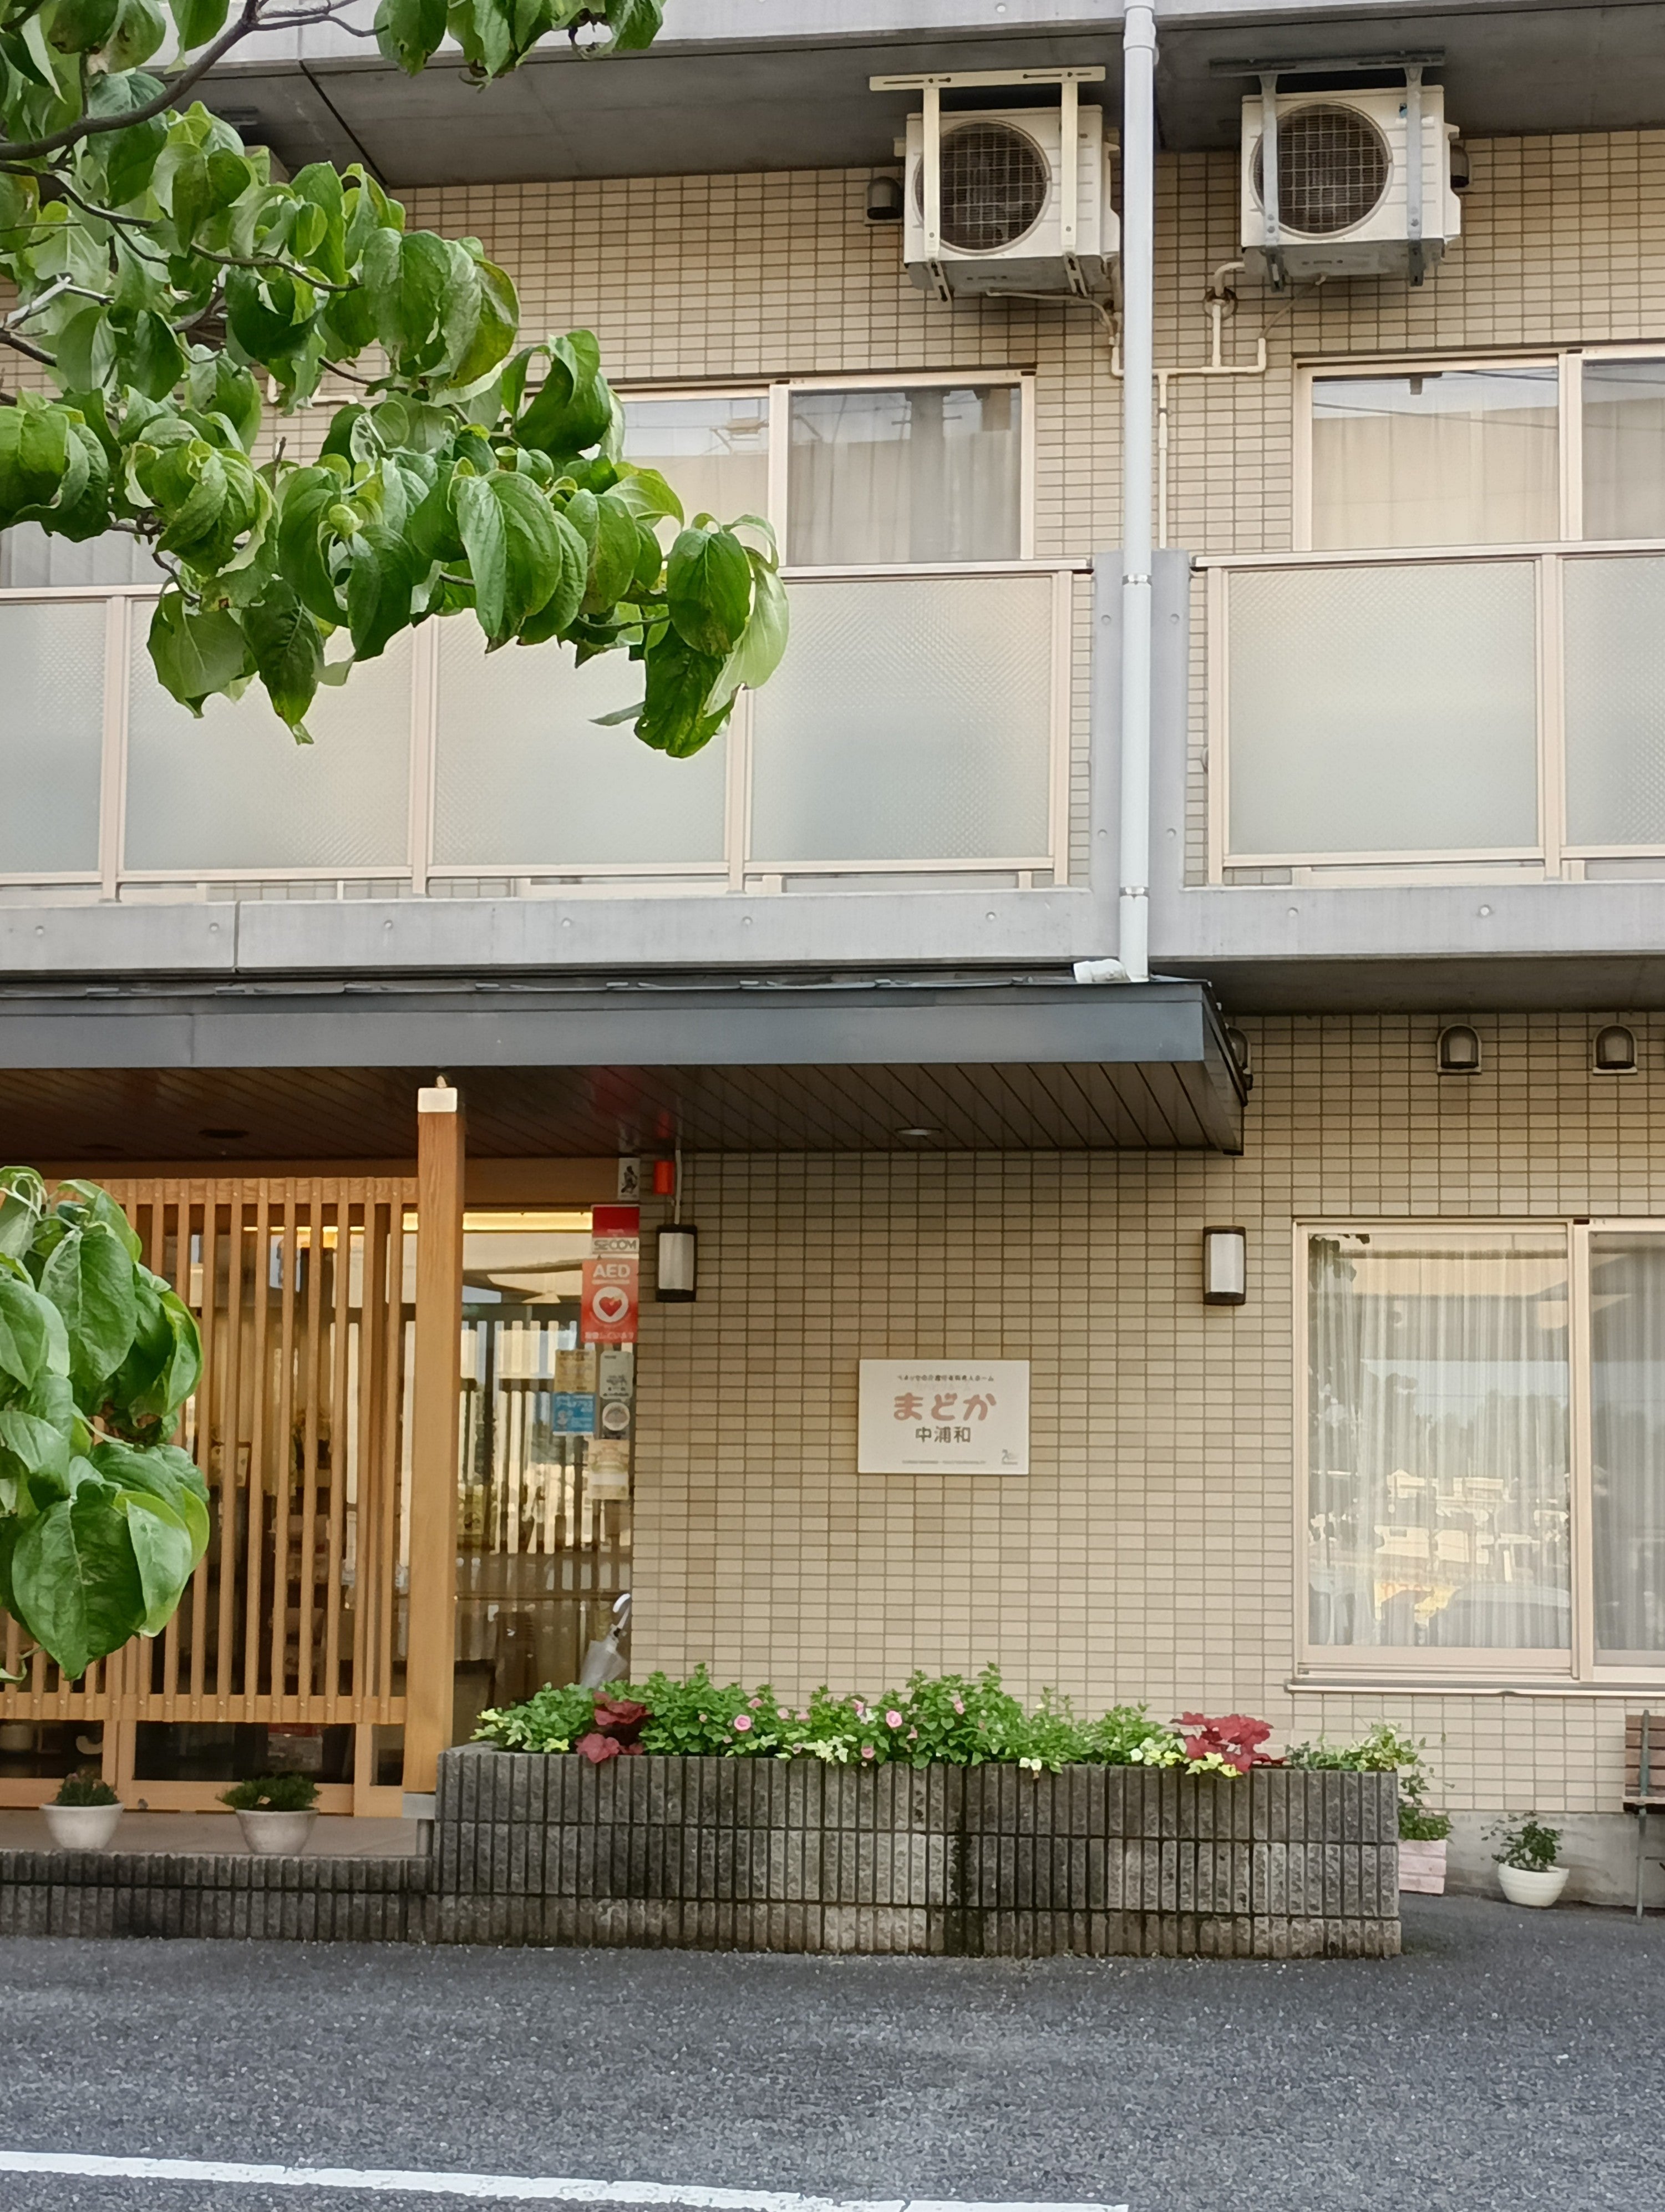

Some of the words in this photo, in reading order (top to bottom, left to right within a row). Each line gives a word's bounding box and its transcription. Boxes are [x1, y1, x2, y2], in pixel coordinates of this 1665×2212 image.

[593, 1264, 631, 1277] AED
[894, 1392, 997, 1421] まどか
[915, 1426, 971, 1443] 中浦和
